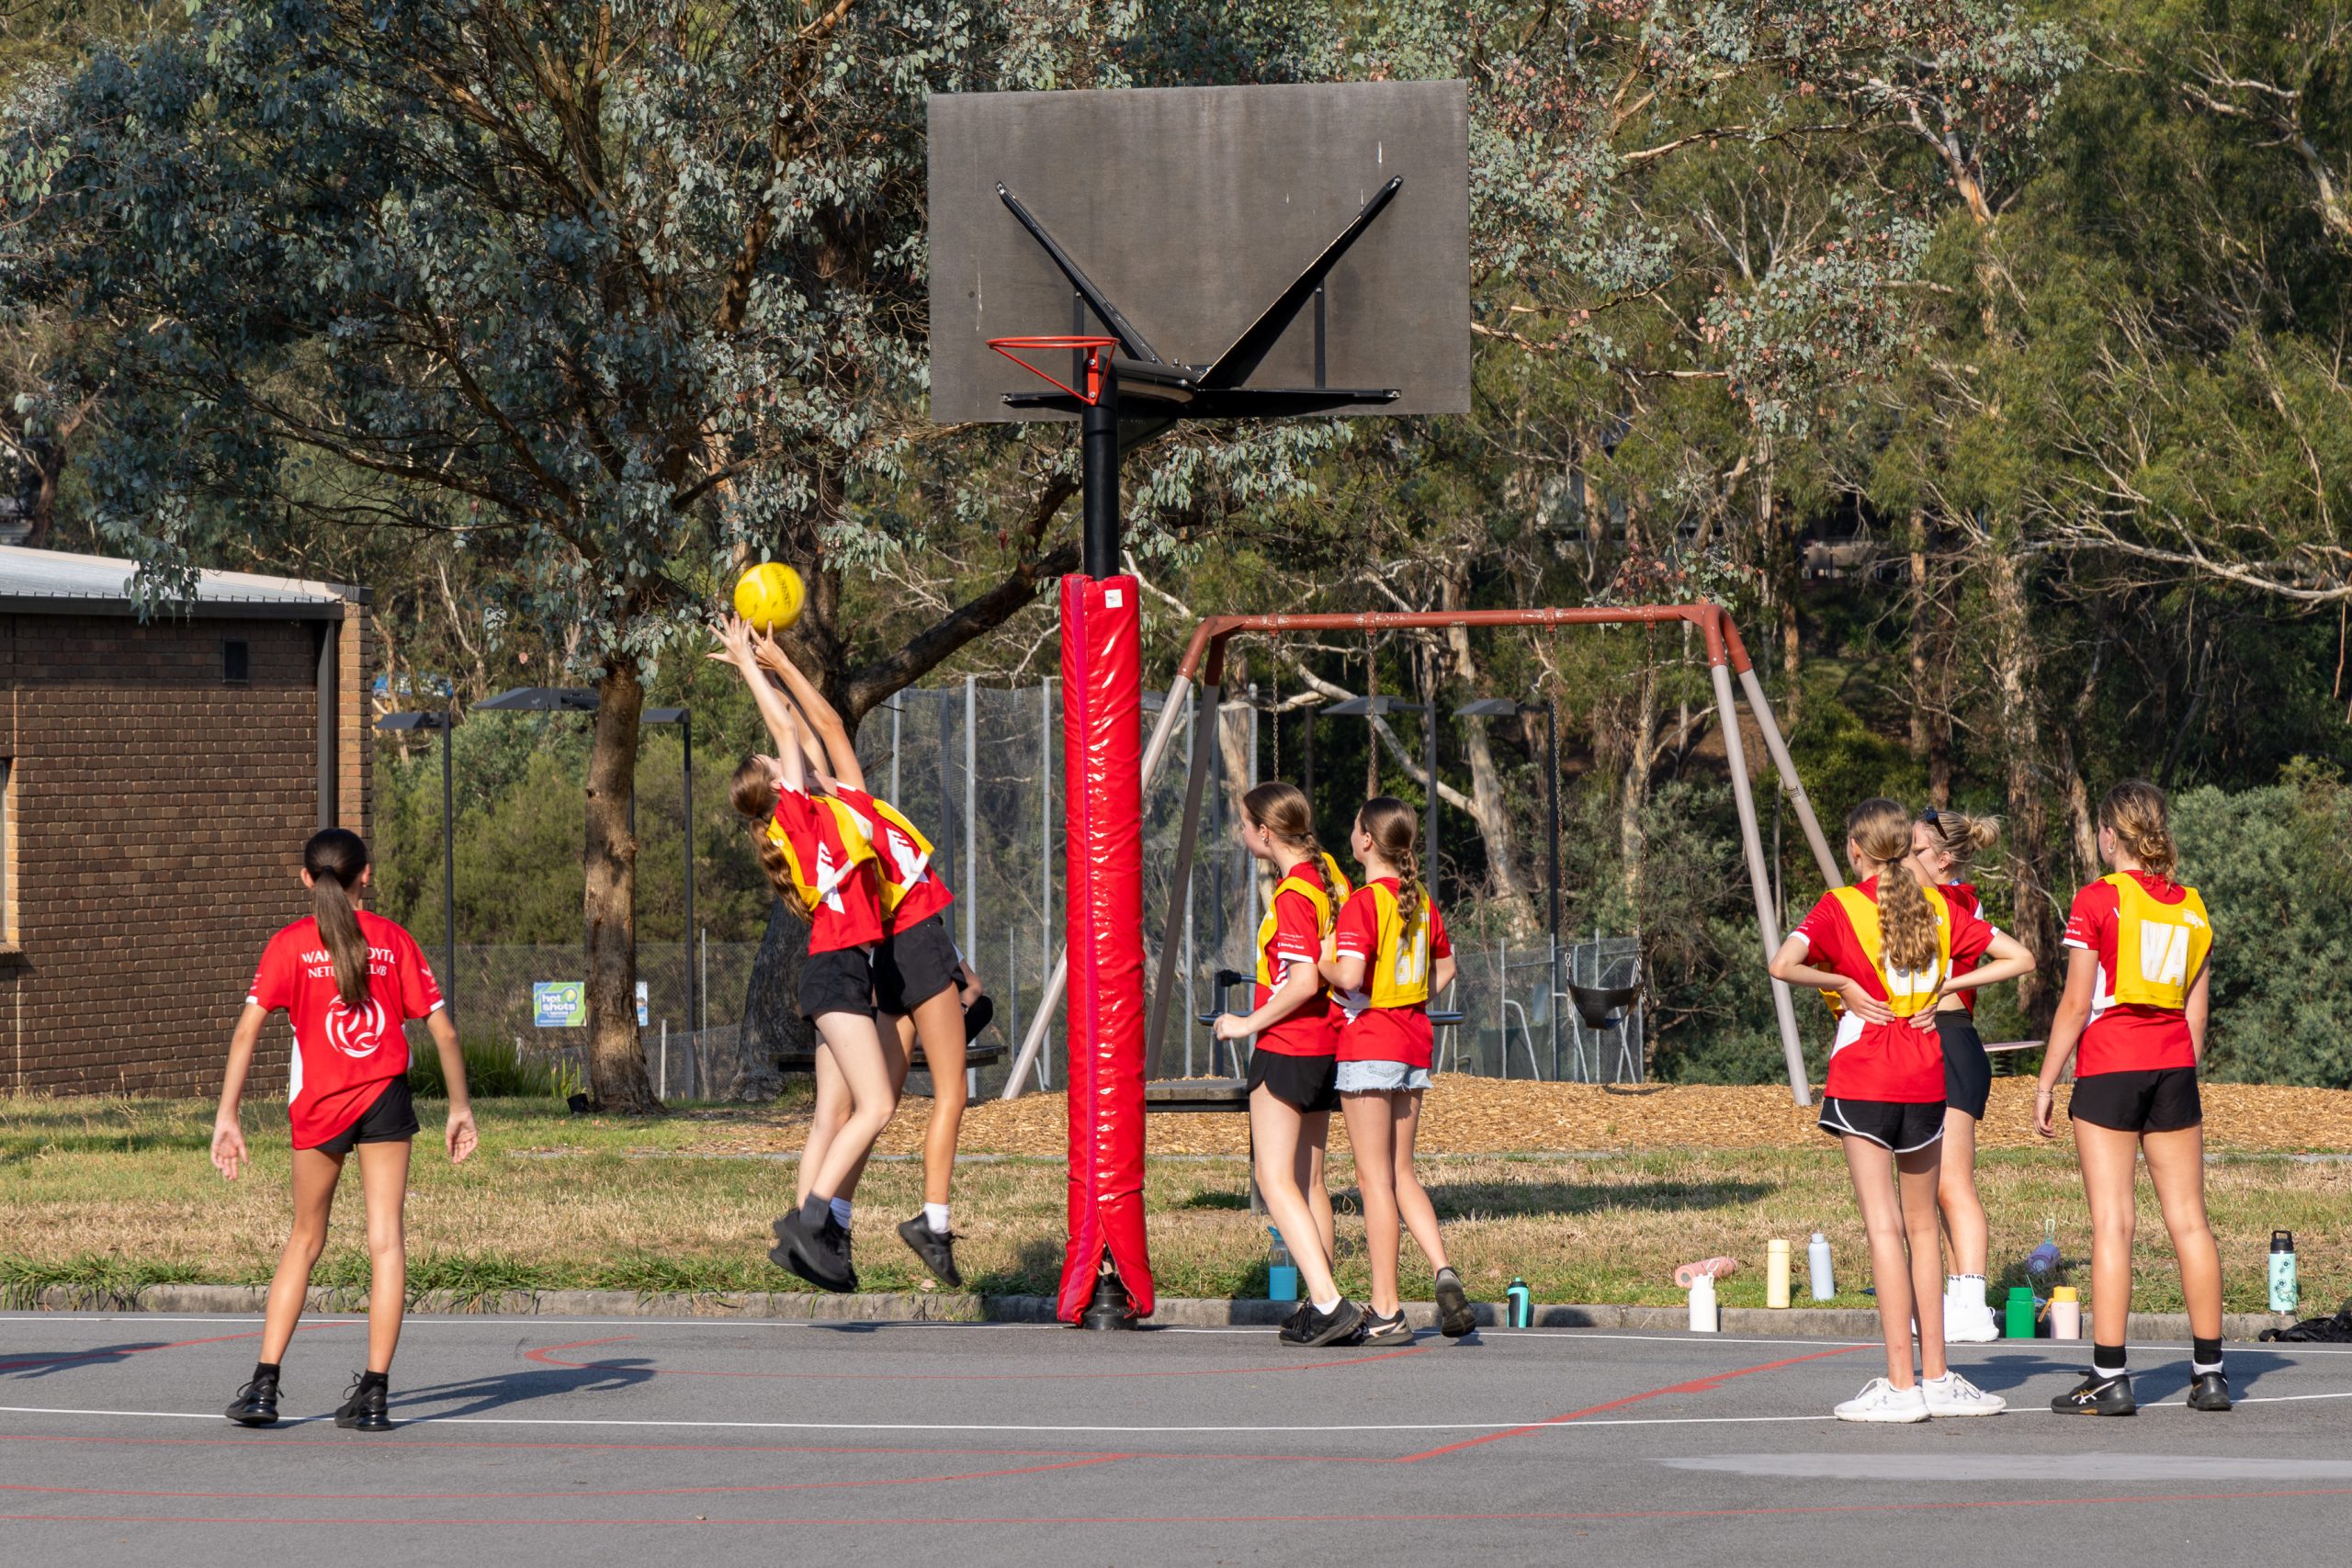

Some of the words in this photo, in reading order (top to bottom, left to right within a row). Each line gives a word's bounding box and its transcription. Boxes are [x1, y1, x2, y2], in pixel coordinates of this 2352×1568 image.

[2140, 919, 2190, 987] WA
[542, 993, 561, 1003] hot
[542, 1002, 576, 1011] shots
